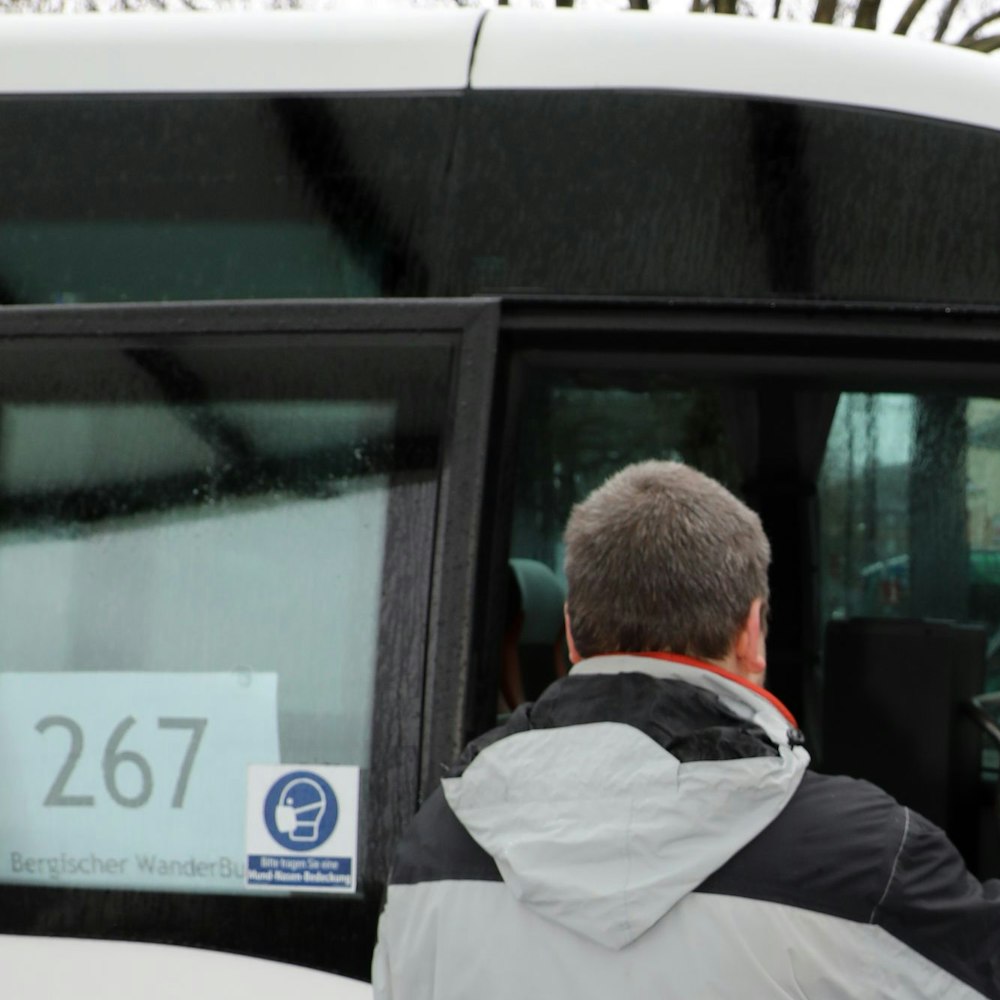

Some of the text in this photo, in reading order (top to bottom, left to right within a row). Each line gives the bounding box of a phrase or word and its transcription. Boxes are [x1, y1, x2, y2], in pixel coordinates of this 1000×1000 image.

[34, 714, 208, 810] 267
[10, 851, 245, 881] Bergischer WanderBu
